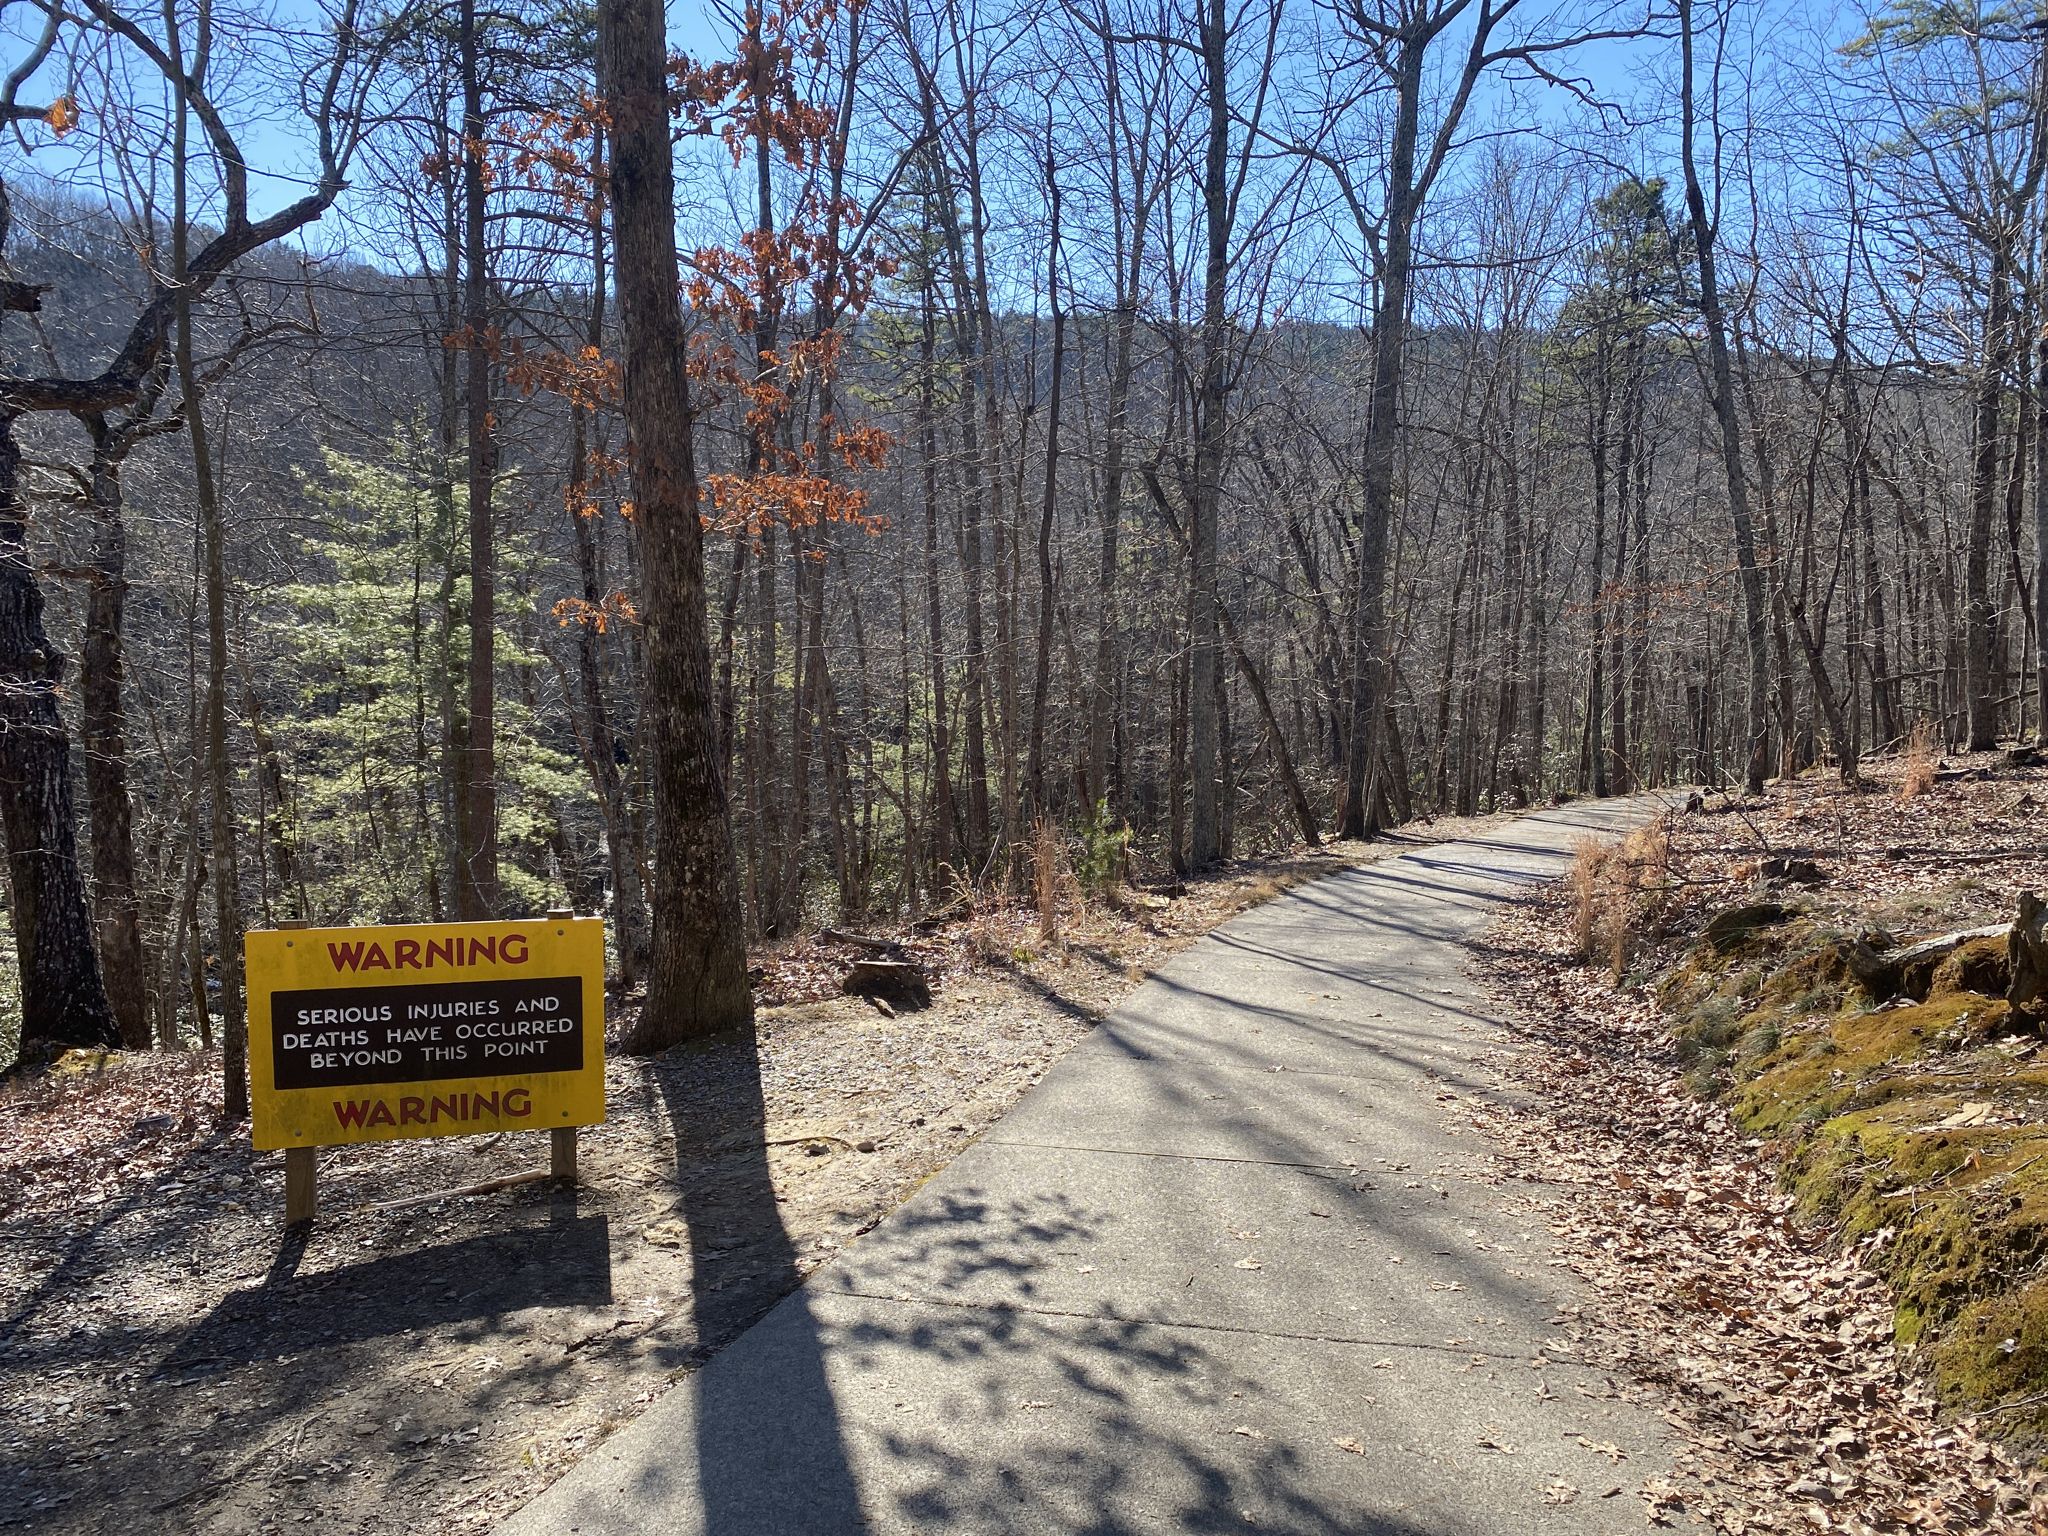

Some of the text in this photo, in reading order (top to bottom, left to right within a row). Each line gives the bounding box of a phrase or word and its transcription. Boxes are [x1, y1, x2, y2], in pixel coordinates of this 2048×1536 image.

[327, 934, 529, 973] WARNING
[297, 996, 560, 1026] SERIOUS INJURIES AND
[282, 1018, 574, 1050] DEATHS HAVE OCCURRED
[310, 1040, 549, 1069] BEYOND THIS POINT
[333, 1088, 532, 1130] WARNING
